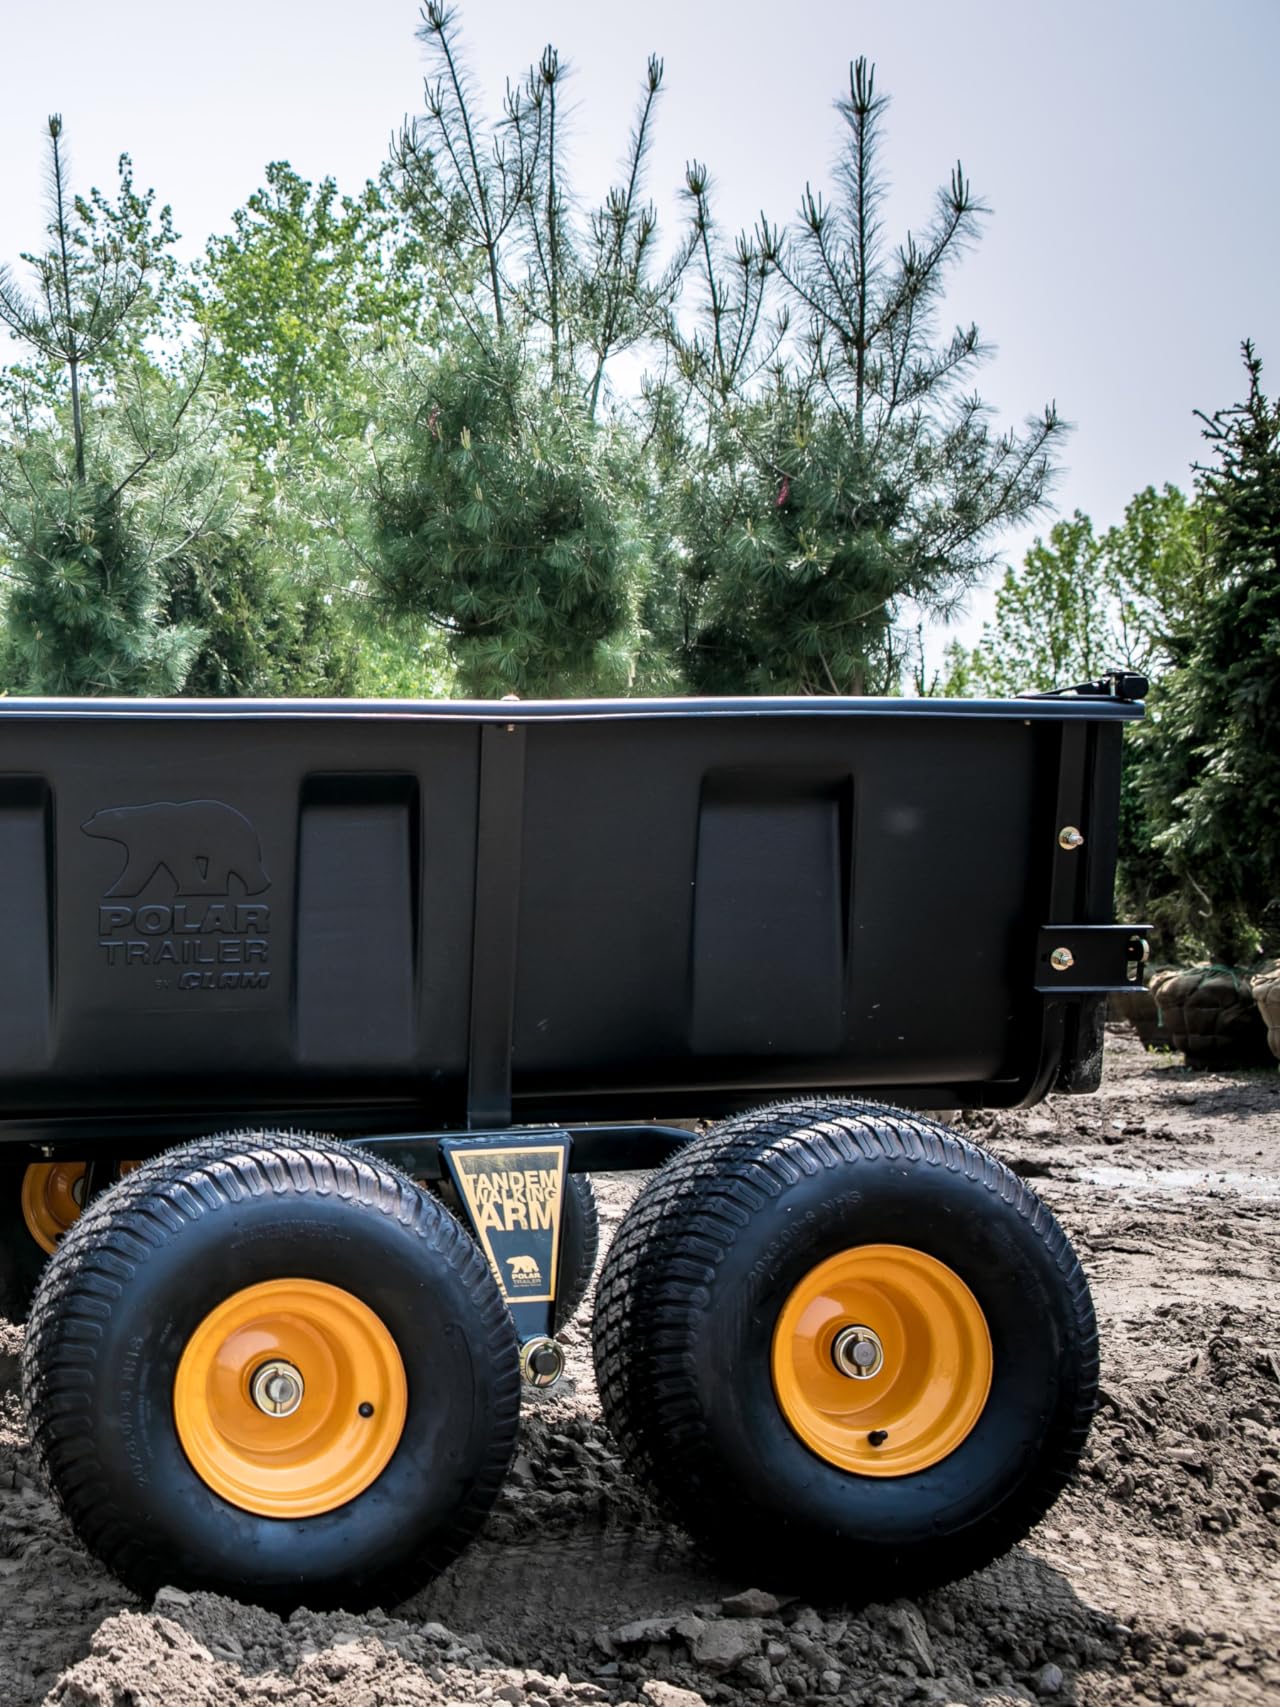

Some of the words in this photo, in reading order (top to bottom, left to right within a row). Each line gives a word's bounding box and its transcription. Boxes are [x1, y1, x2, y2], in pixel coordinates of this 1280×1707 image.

[98, 904, 270, 937] POLAR
[99, 939, 270, 967] TRAILER
[177, 972, 270, 990] CLAM
[465, 1168, 558, 1191] TANDEM
[473, 1186, 558, 1205] WALKING
[478, 1200, 554, 1231] ARM
[511, 1272, 541, 1280] POLAR
